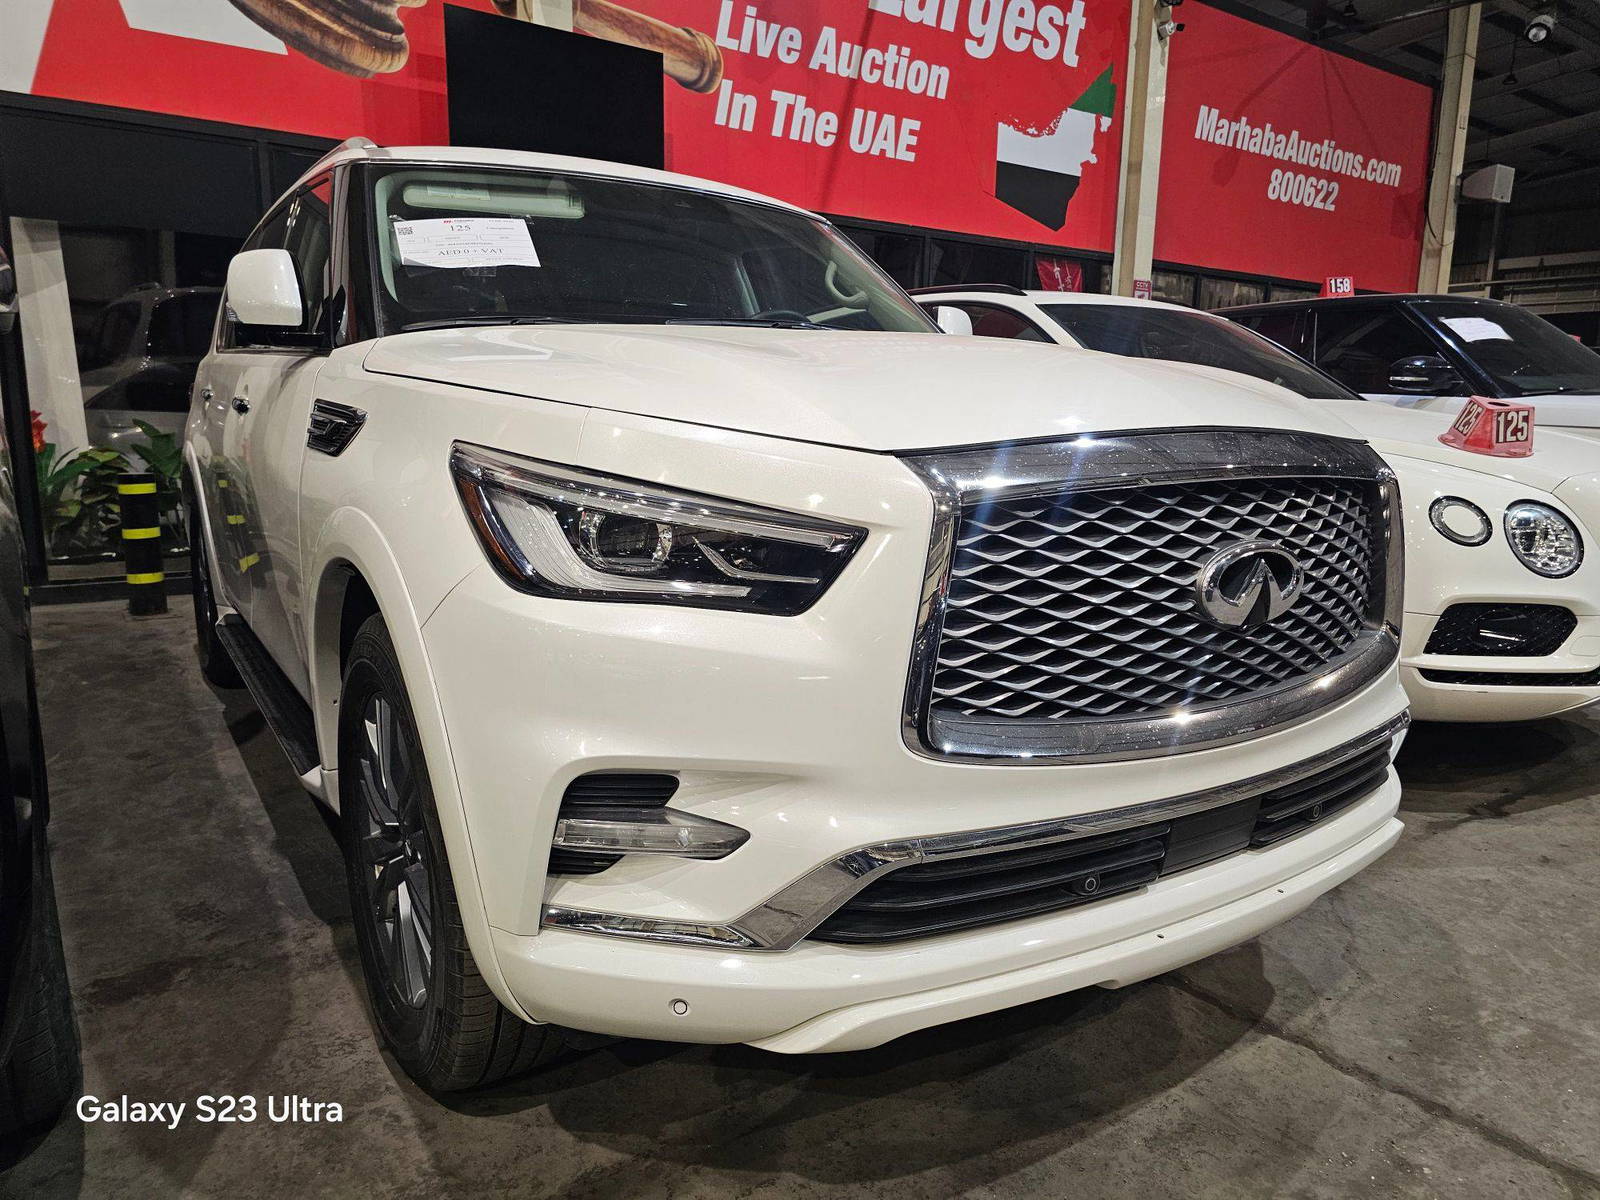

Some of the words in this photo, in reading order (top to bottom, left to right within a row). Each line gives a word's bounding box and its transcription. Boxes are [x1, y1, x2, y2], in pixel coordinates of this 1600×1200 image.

[715, 0, 803, 65] Live
[808, 26, 950, 100] Auction
[714, 79, 758, 132] In
[770, 90, 839, 148] The
[849, 108, 922, 163] UAE
[1194, 104, 1402, 188] MarhabaAuctions.com
[1267, 168, 1340, 212] 800622
[449, 224, 471, 232] 125
[1455, 402, 1483, 435] 125
[1497, 410, 1529, 443] 125
